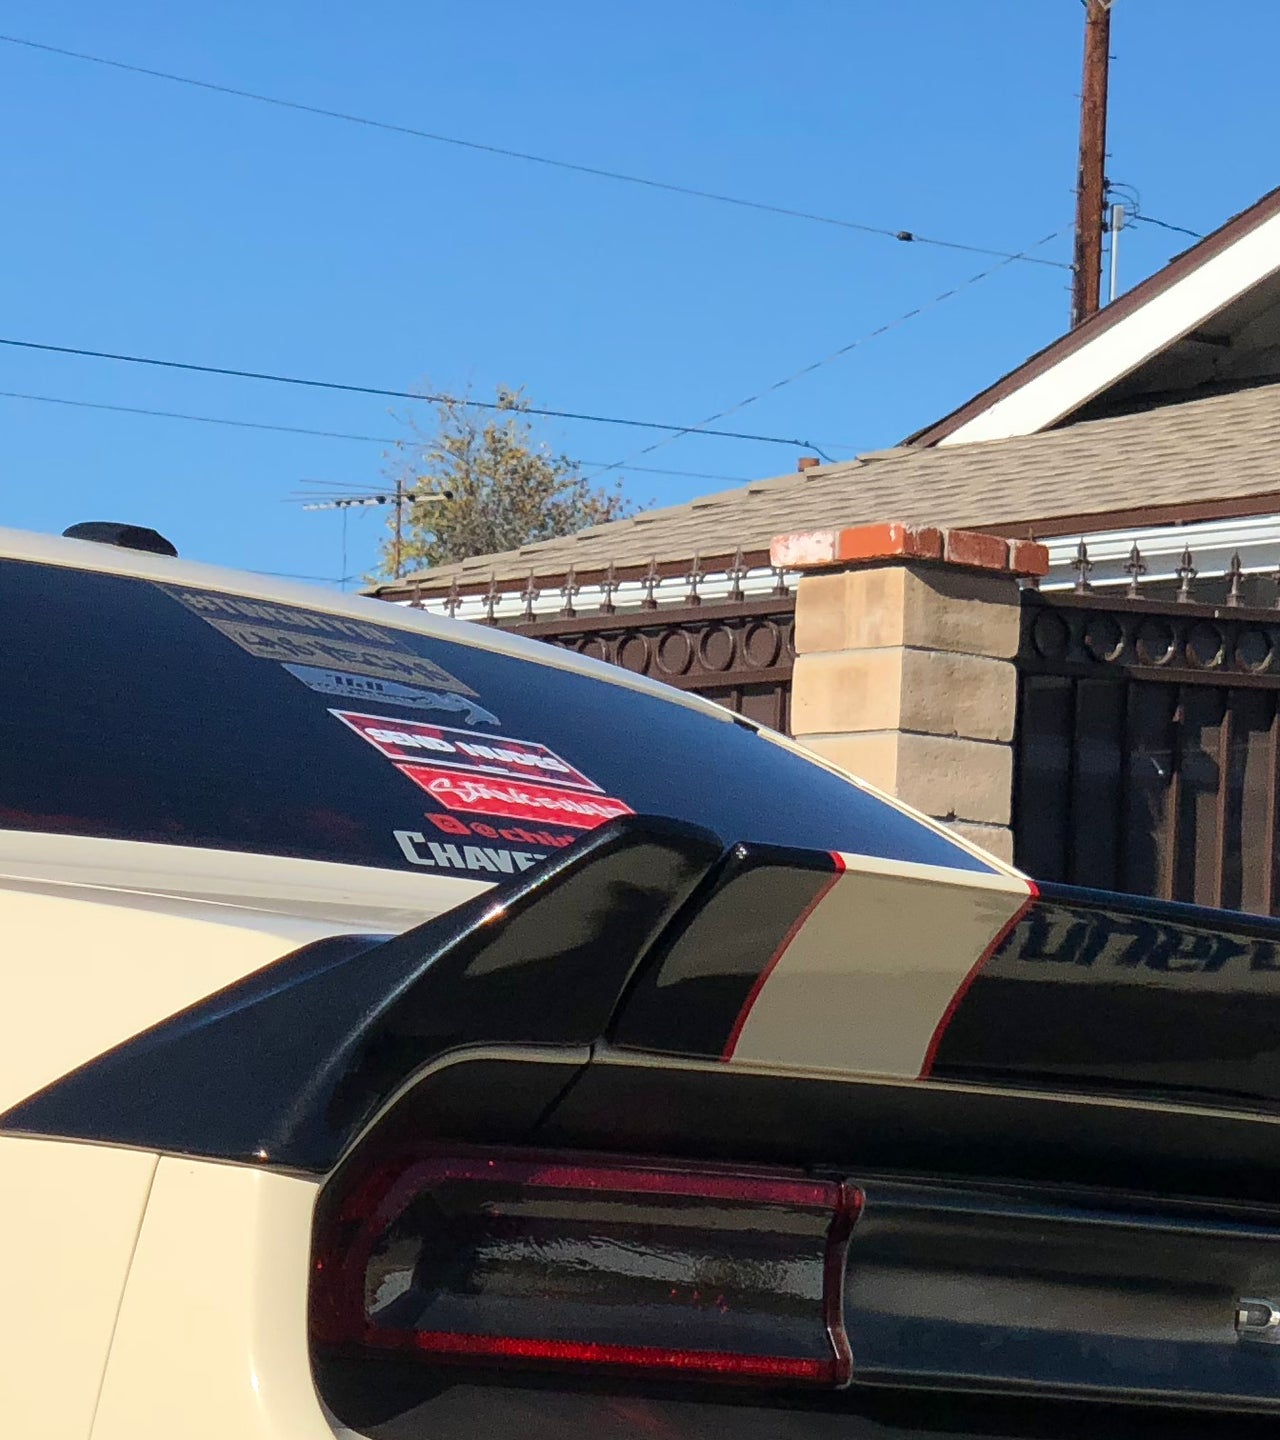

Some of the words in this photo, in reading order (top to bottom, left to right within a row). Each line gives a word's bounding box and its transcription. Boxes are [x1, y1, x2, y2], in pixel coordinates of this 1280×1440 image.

[364, 726, 457, 753] SEND
[456, 741, 571, 773] NUDES
[393, 830, 548, 874] CHAVE
